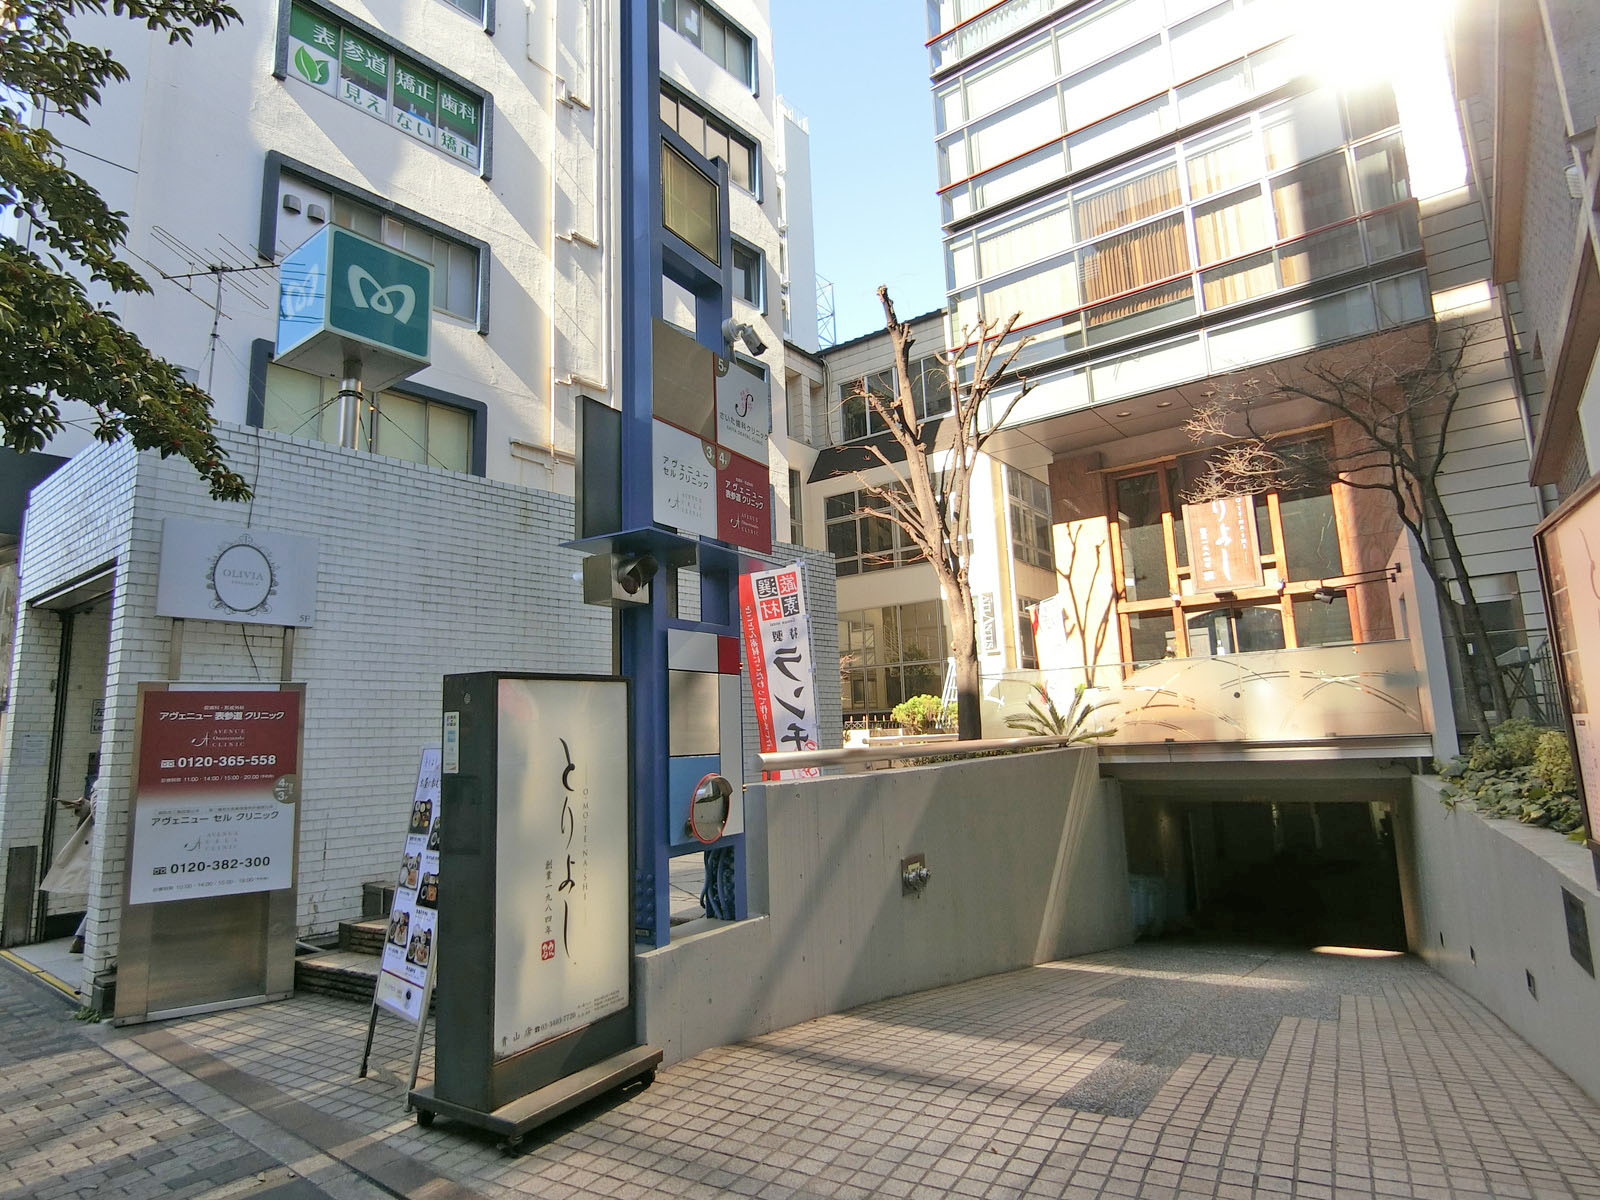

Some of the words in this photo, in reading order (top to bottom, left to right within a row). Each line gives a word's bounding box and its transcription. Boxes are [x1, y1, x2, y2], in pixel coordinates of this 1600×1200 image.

[719, 411, 769, 441] さいた歯科クリニック
[663, 455, 709, 478] アヴェニュー
[663, 467, 677, 480] セル
[679, 472, 709, 490] クリニック
[725, 479, 764, 499] アヴェニュー
[725, 489, 742, 504] 表参道
[742, 494, 764, 511] クリニック
[223, 568, 264, 581] OLIVIA
[299, 614, 311, 624] 5F
[159, 712, 213, 720] アヴェニュー
[214, 711, 244, 721] 表参道
[244, 711, 285, 720] クリニック
[177, 754, 277, 769] 0120-365-558
[151, 816, 209, 826] アヴェニュー
[213, 813, 233, 823] セル
[236, 810, 280, 820] クリニック
[557, 736, 576, 960] とりよし
[170, 856, 271, 874] 0120-382-300
